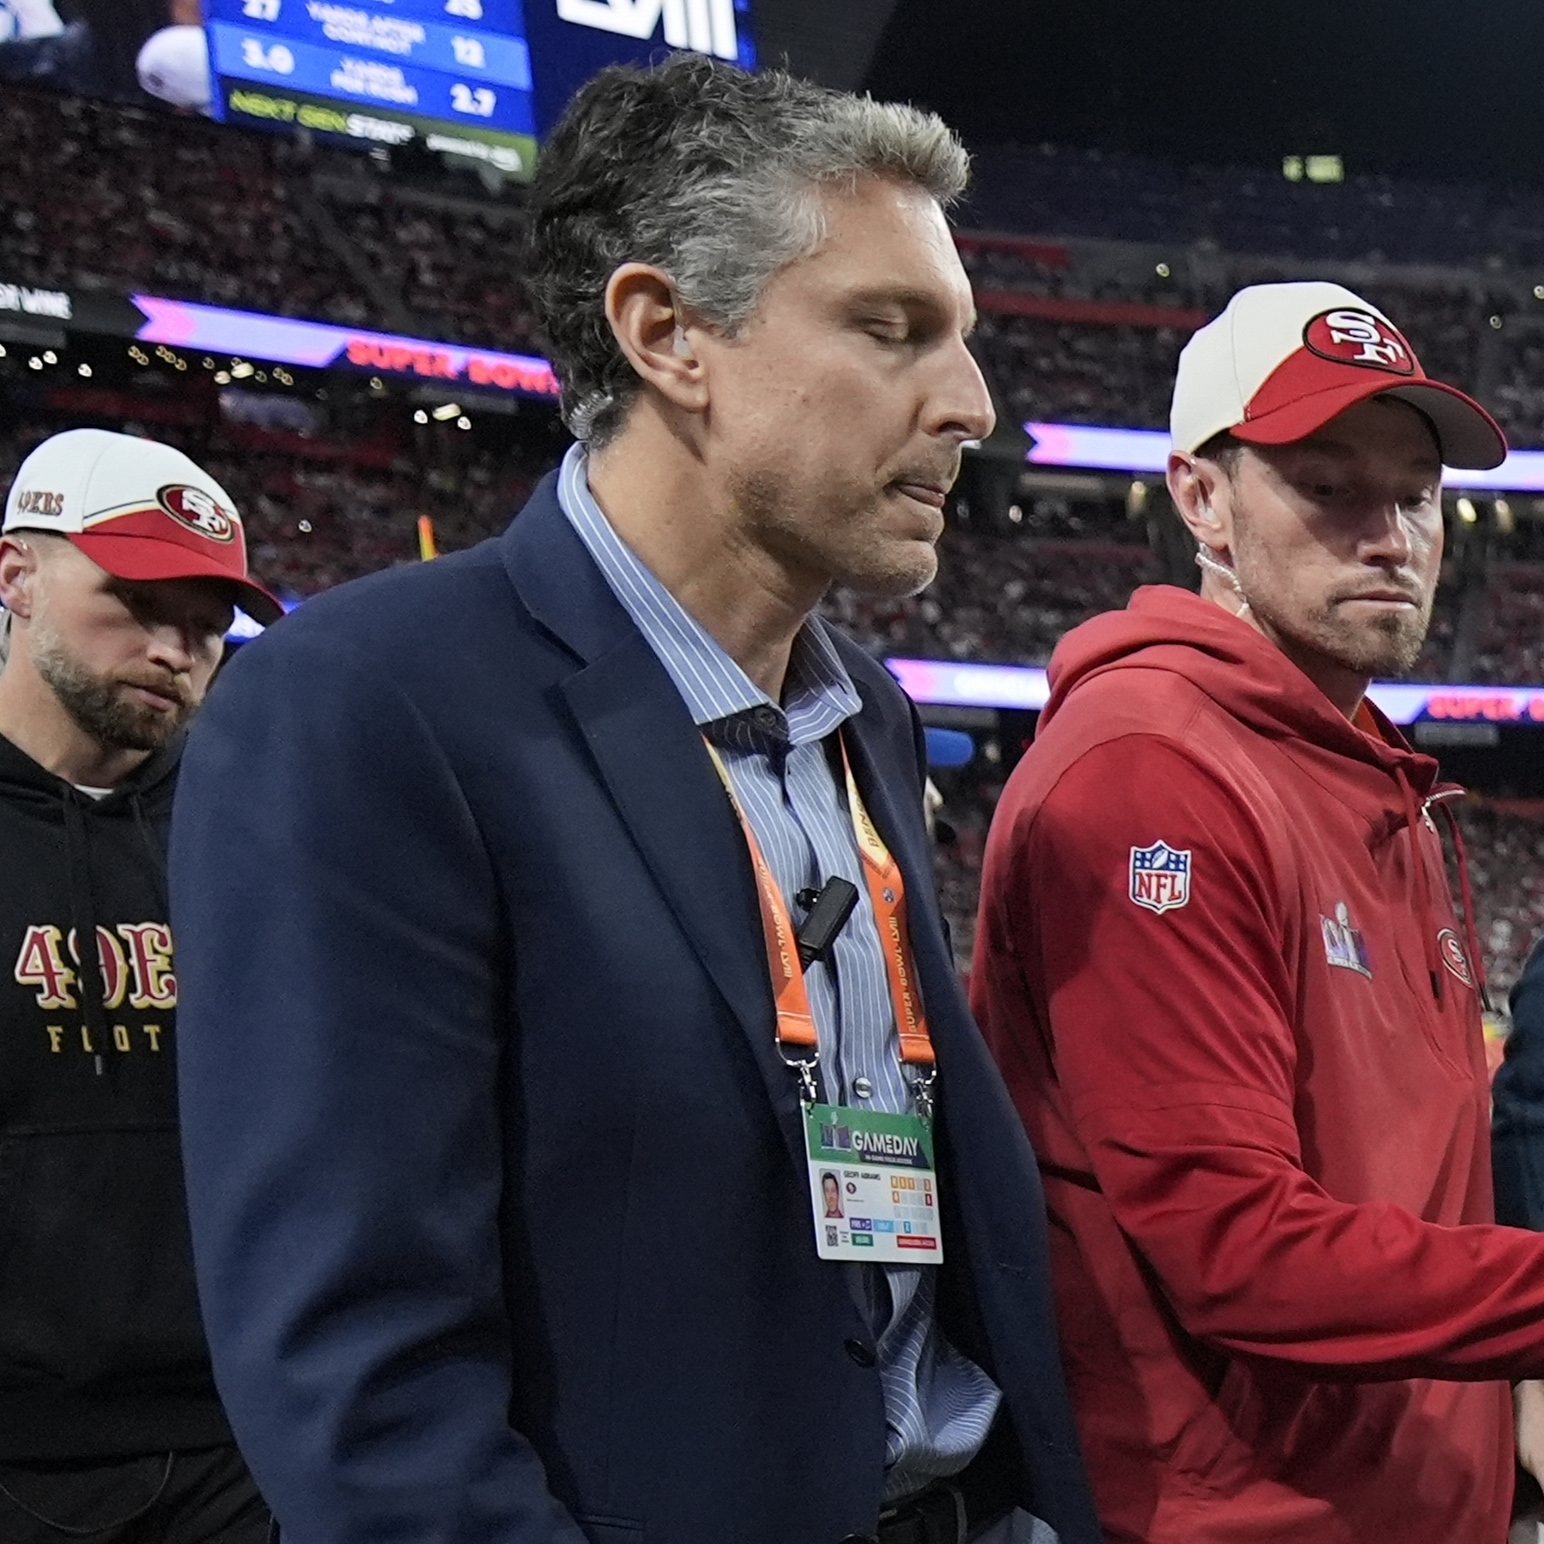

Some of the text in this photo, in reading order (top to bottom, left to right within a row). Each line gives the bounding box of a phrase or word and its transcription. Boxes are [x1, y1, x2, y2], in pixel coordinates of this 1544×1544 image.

[1426, 696, 1522, 721] SUPER
[1135, 872, 1182, 905] NFL
[892, 943, 909, 988] BOWL
[899, 987, 918, 1034] SUPER
[852, 1130, 919, 1157] GAMEDAY
